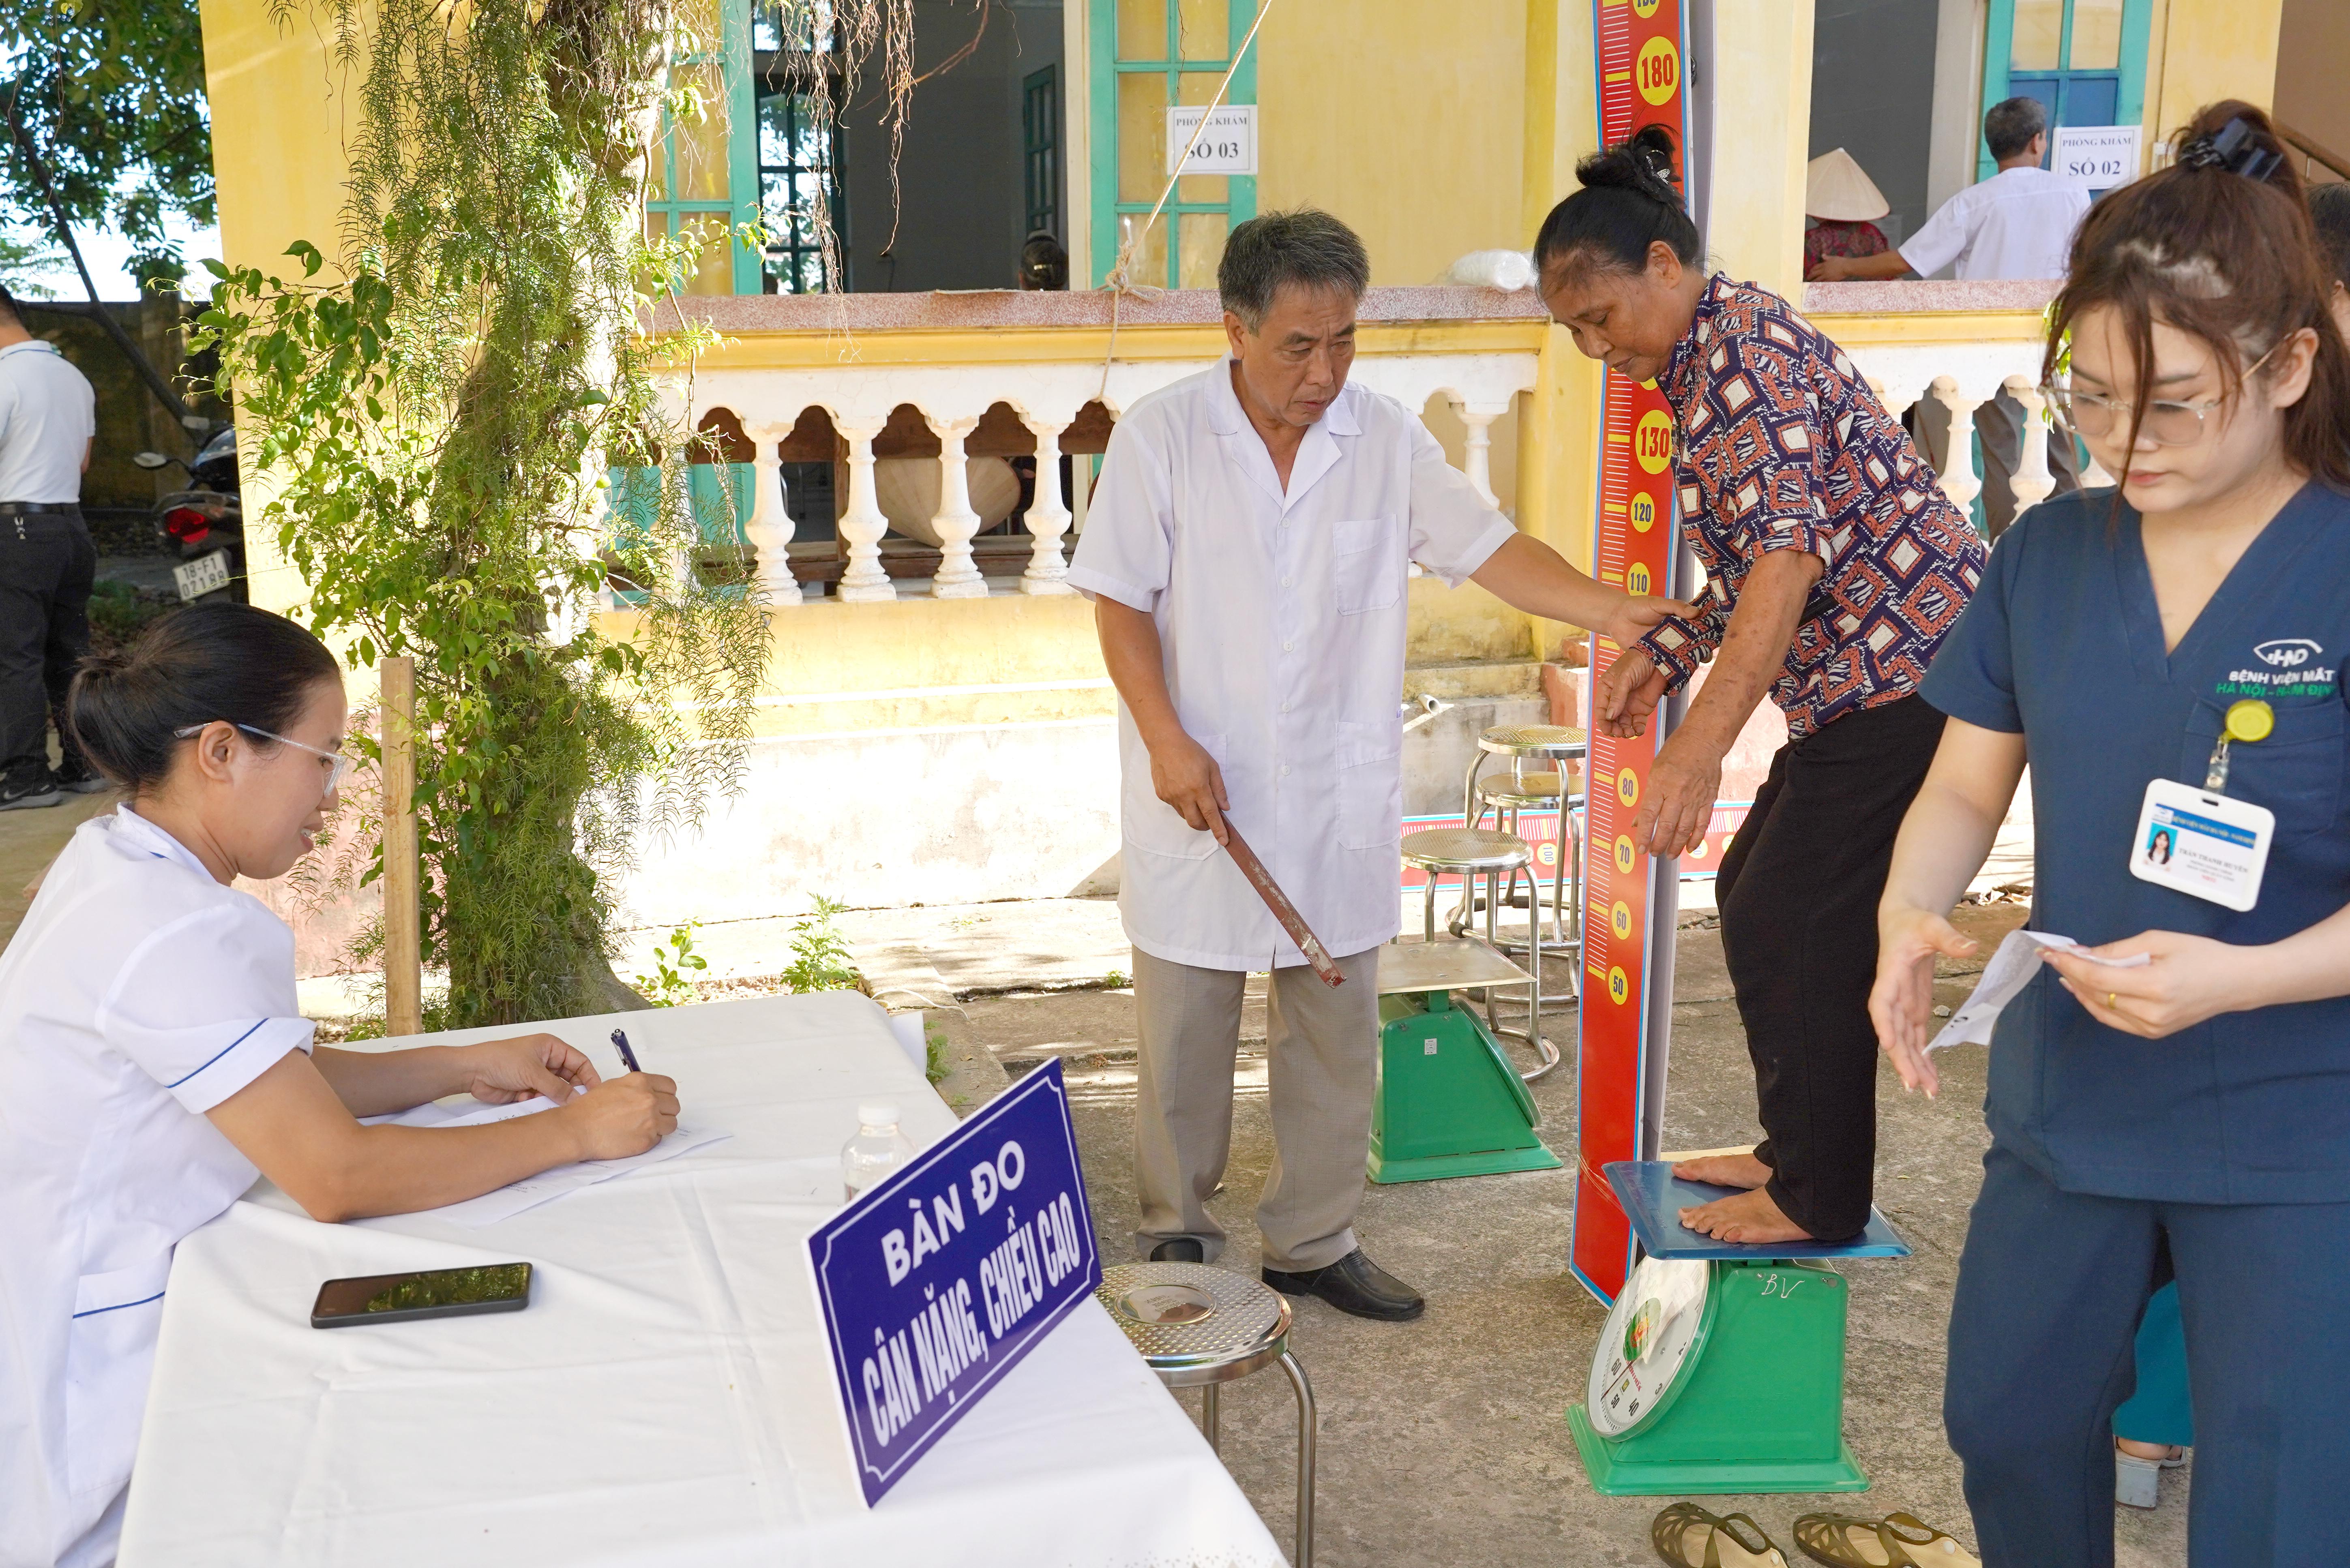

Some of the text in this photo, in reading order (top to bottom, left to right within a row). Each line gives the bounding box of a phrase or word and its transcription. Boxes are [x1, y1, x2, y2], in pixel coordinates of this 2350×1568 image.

[1642, 54, 1673, 89] 180
[1216, 114, 1247, 125] KHÁM
[1218, 142, 1238, 158] 03
[2063, 135, 2131, 146] PHÒNG KHÁM
[2069, 157, 2121, 176] SỐ 02
[1640, 426, 1669, 458] 130
[1634, 502, 1651, 523] 120
[1630, 572, 1647, 593] 110
[2229, 669, 2269, 684] BỆNH
[2272, 671, 2301, 685] VIỆN
[1623, 778, 1634, 797] 80
[1543, 846, 1554, 862] 100
[1619, 844, 1630, 864] 70
[1616, 910, 1627, 930] 60
[1612, 975, 1623, 995] 50
[881, 1140, 1025, 1287] BÀN ĐO
[863, 1191, 1081, 1447] CÂN NẶNG, CHIỀU CAO
[1611, 1358, 1621, 1376] 60
[1655, 1383, 1663, 1396] 3
[1611, 1393, 1620, 1409] 50
[1629, 1398, 1640, 1417] 40
